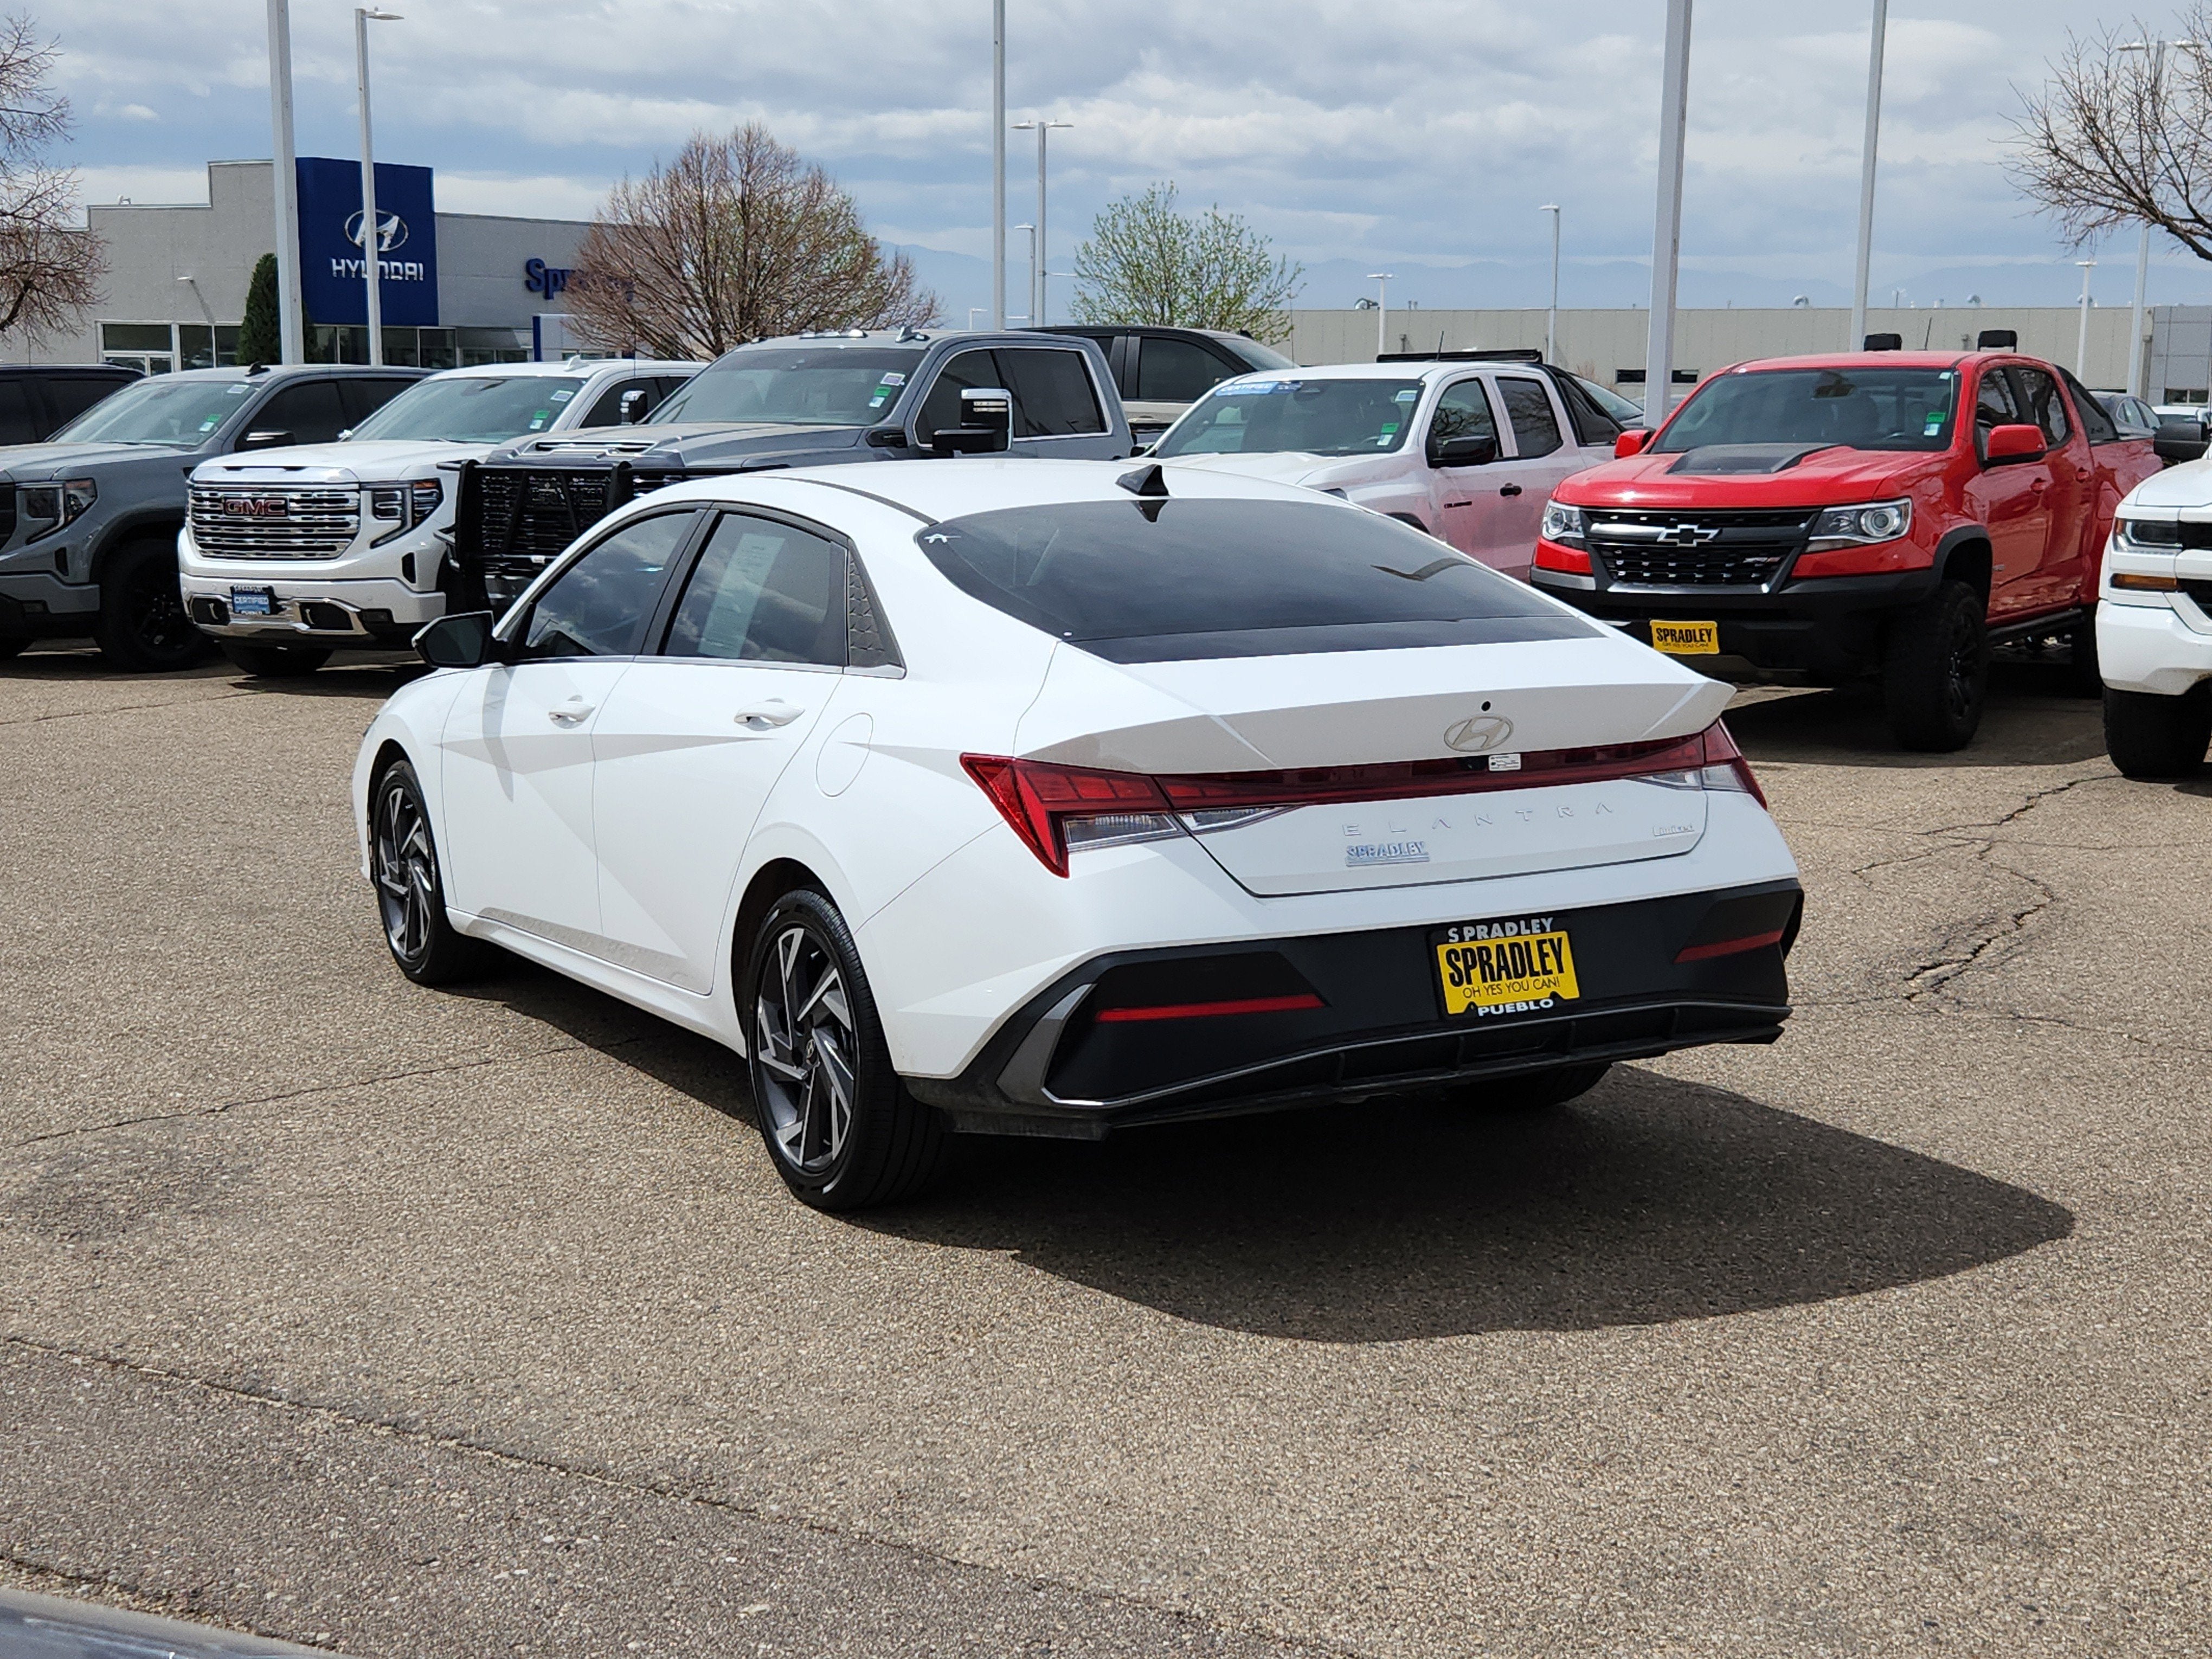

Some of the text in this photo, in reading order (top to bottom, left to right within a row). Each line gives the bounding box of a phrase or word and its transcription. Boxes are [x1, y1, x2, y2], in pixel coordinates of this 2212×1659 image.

[225, 499, 286, 515] GMC
[1656, 627, 1712, 642] SPRADLEY
[1342, 801, 1613, 837] ELANTRA
[1346, 840, 1426, 859] SPRADLEY
[1448, 917, 1553, 943] SPRADLEY
[1445, 937, 1564, 987] SPRADLEY
[1462, 976, 1560, 999] OH YES YOU CAN!
[1477, 999, 1554, 1017] PUEBLO
